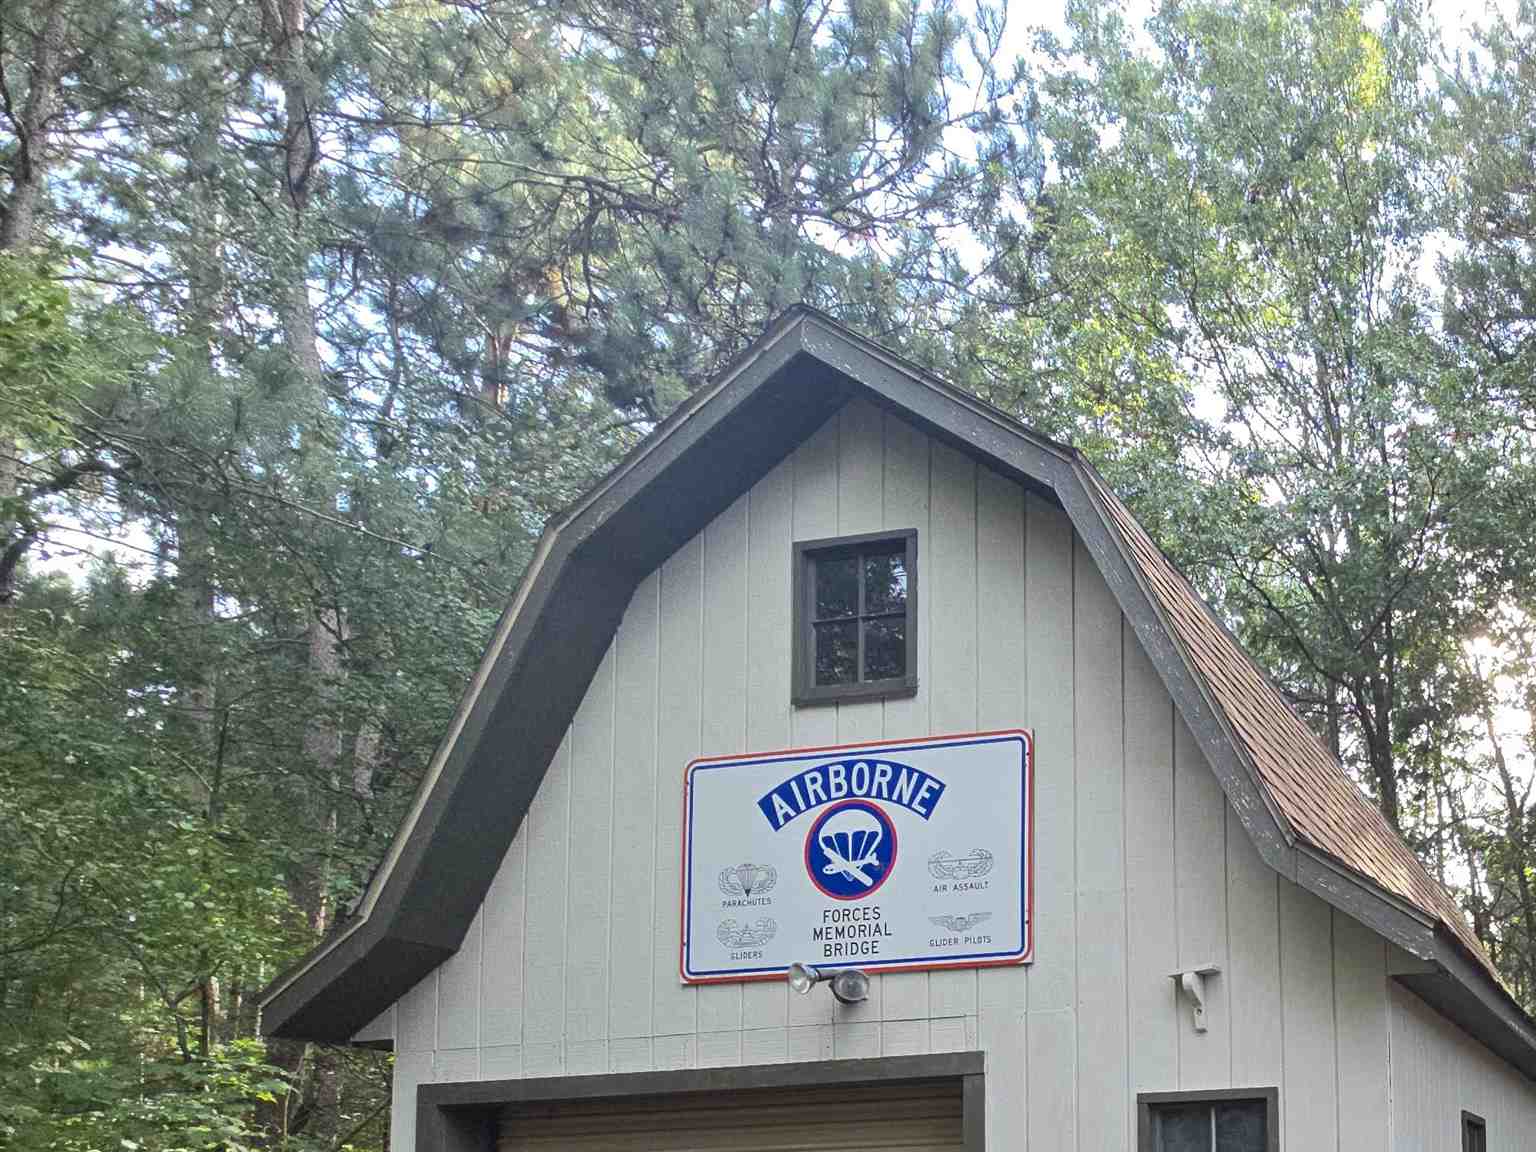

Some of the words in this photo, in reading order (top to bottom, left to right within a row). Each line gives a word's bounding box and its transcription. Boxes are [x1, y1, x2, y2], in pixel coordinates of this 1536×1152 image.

[771, 762, 940, 826] AIRBORNE
[933, 884, 950, 893] AIR
[953, 880, 990, 891] ASSAULT
[721, 896, 773, 908] PARACHUTES
[823, 906, 881, 923] FORCES
[812, 921, 893, 941] MEMORIAL
[823, 940, 880, 957] BRIDGE
[928, 936, 959, 947] GLIDER
[964, 935, 992, 945] PILOTS
